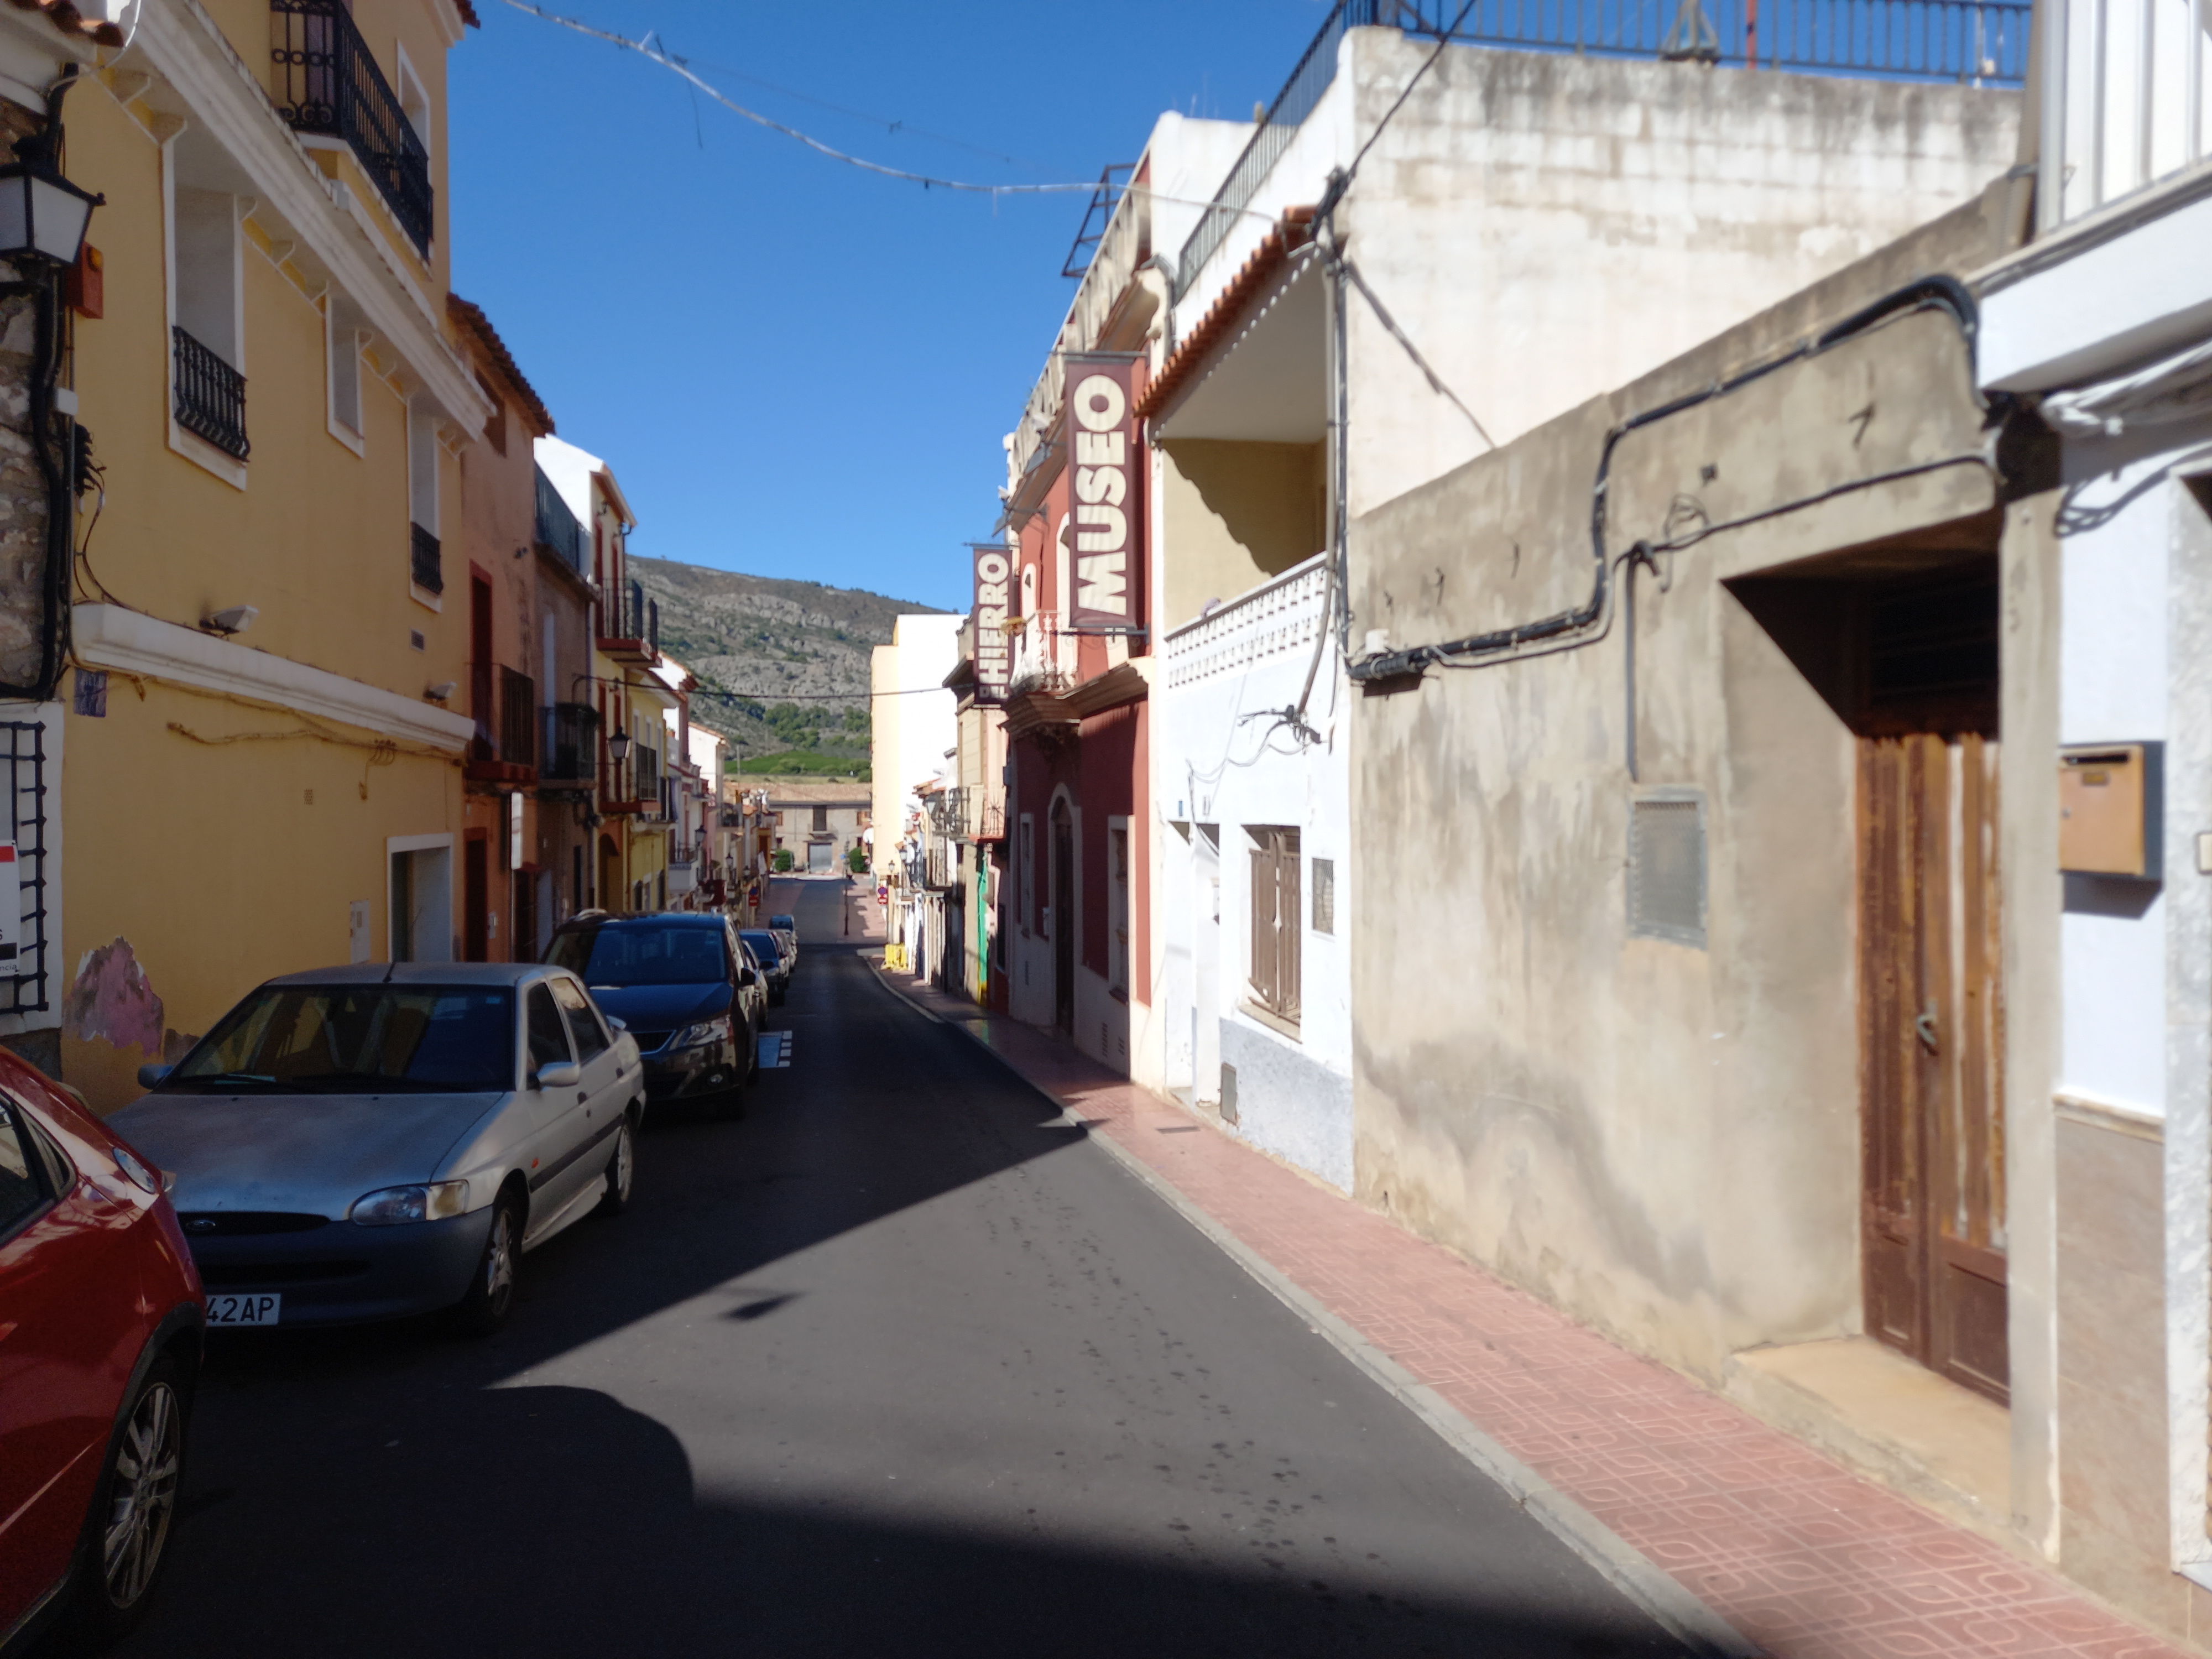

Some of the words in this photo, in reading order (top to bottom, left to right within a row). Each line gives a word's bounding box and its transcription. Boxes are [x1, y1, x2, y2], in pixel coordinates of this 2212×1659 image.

[1073, 374, 1127, 616] MUSEO
[978, 553, 1009, 684] HIERRO
[979, 686, 1009, 699] DEL
[207, 1297, 274, 1322] 42AP
